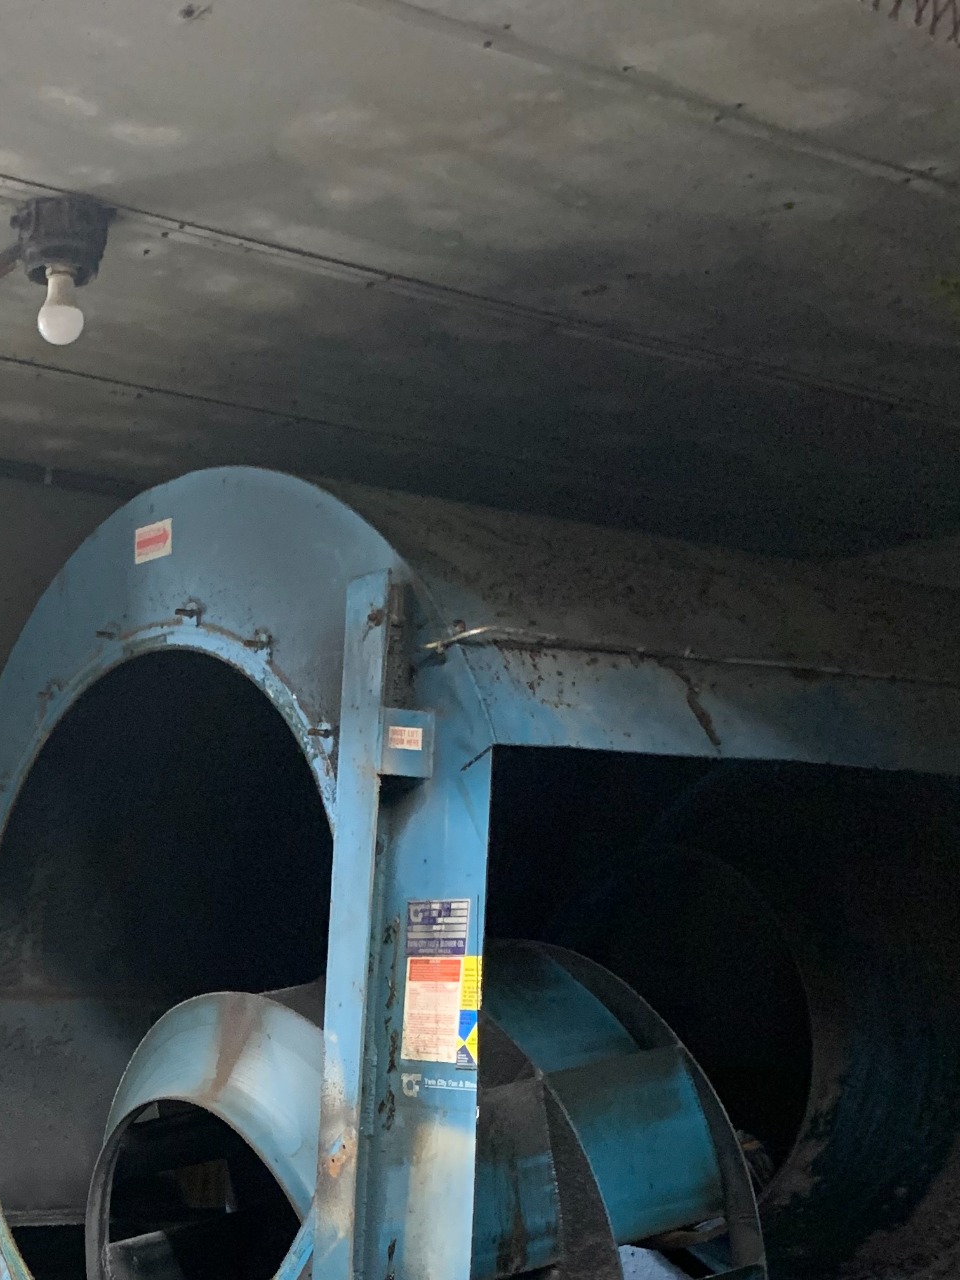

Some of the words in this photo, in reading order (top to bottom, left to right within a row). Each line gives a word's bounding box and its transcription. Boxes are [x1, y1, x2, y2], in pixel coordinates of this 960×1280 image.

[424, 1078, 436, 1086] Twin
[437, 1078, 447, 1087] City
[448, 1079, 458, 1087] Fan
